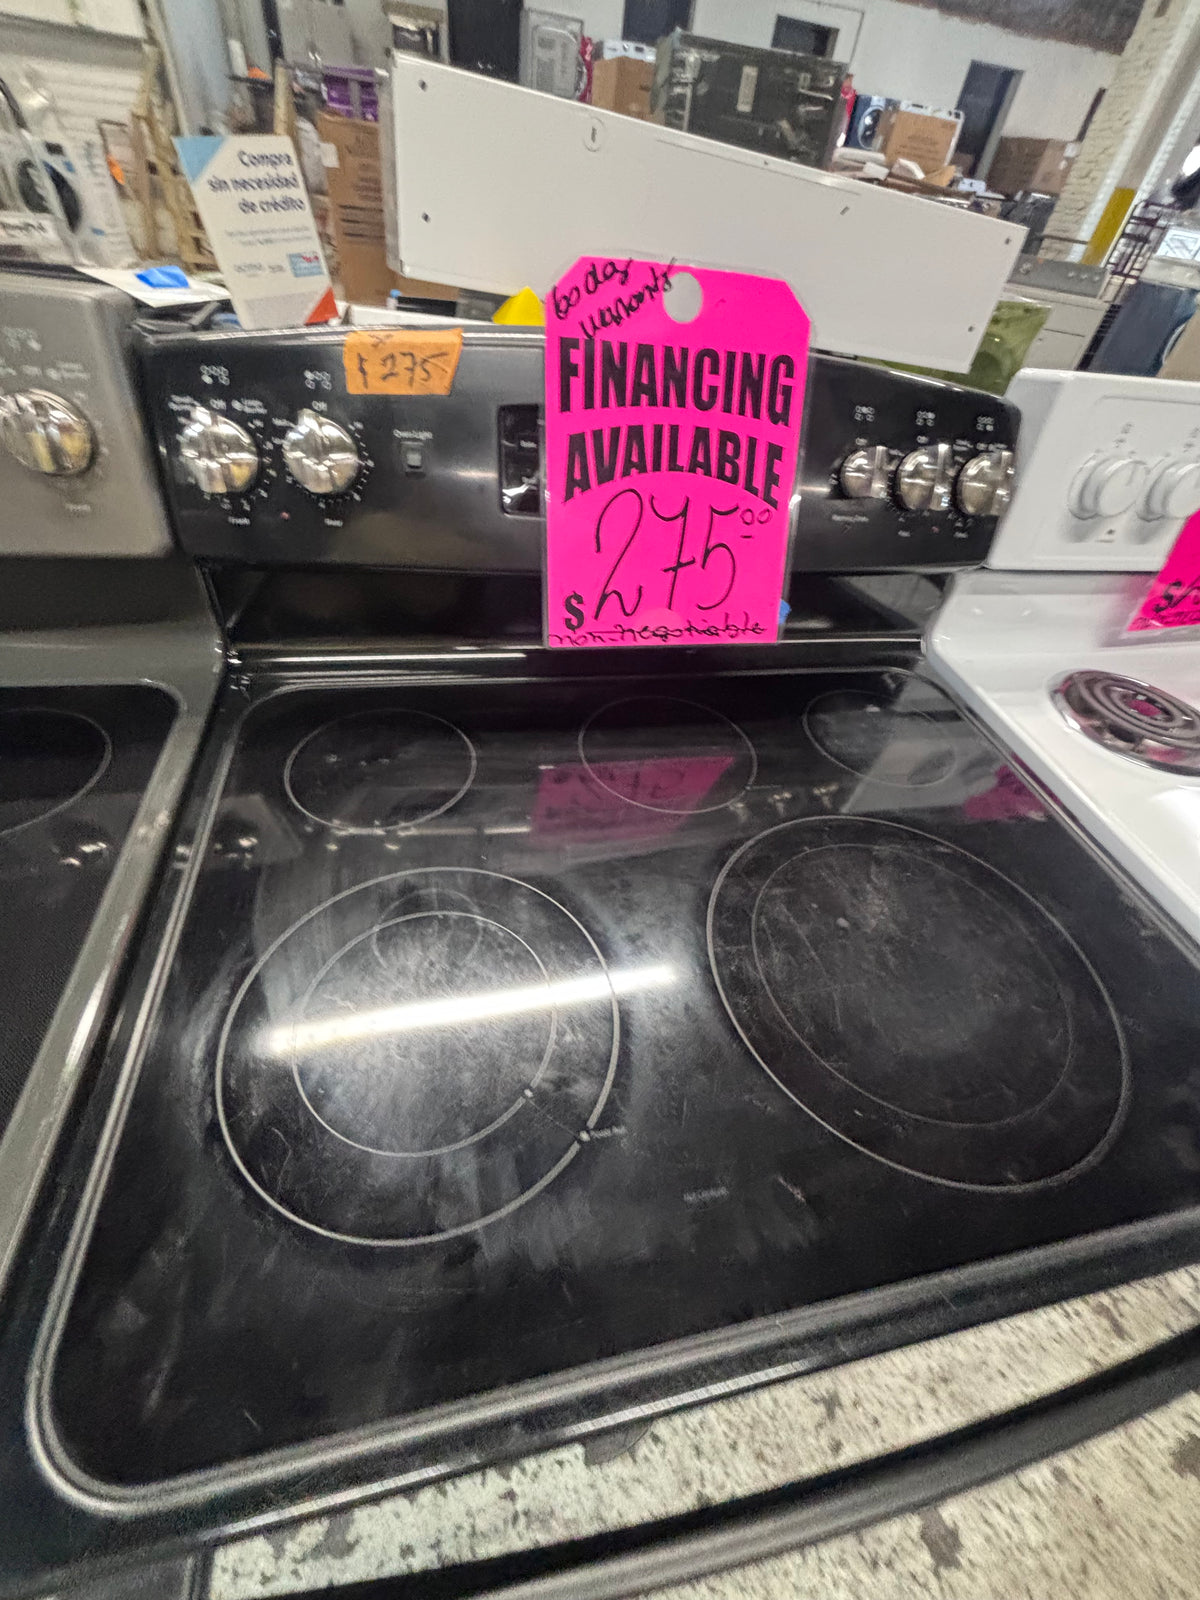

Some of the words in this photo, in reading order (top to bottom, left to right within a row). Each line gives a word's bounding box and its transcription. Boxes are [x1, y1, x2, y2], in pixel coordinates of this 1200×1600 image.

[238, 150, 294, 168] Compra
[208, 176, 230, 192] sin
[231, 172, 299, 192] necesidad
[238, 198, 259, 214] de
[261, 194, 306, 213] crédito
[560, 337, 795, 427] FINANCING
[564, 424, 783, 510] AVAILABLE
